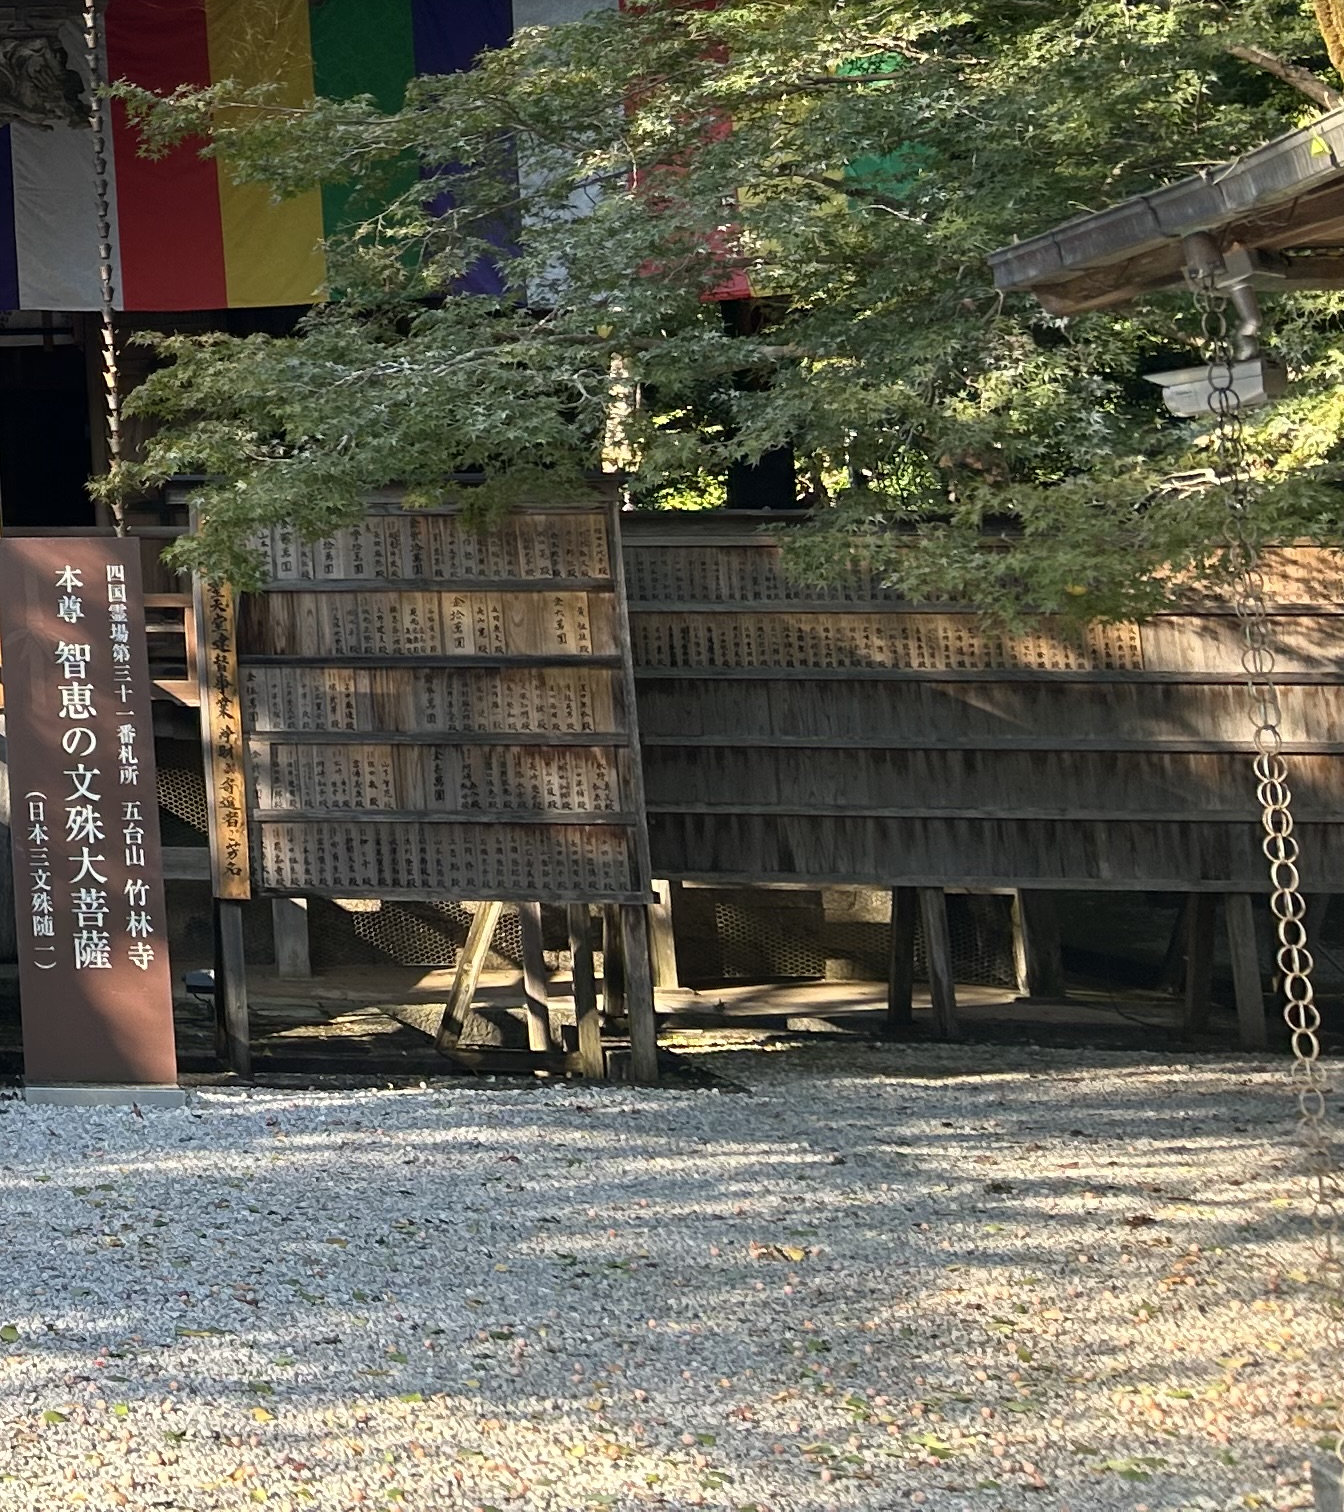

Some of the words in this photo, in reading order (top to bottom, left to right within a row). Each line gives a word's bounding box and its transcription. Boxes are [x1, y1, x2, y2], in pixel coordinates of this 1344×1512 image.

[54, 565, 85, 624] 本尊
[106, 564, 140, 787] 四国霊場第三十一番札所
[54, 640, 114, 970] 智恵の文殊大菩薩
[122, 801, 146, 868] 五台山
[124, 878, 155, 971] 竹林寺
